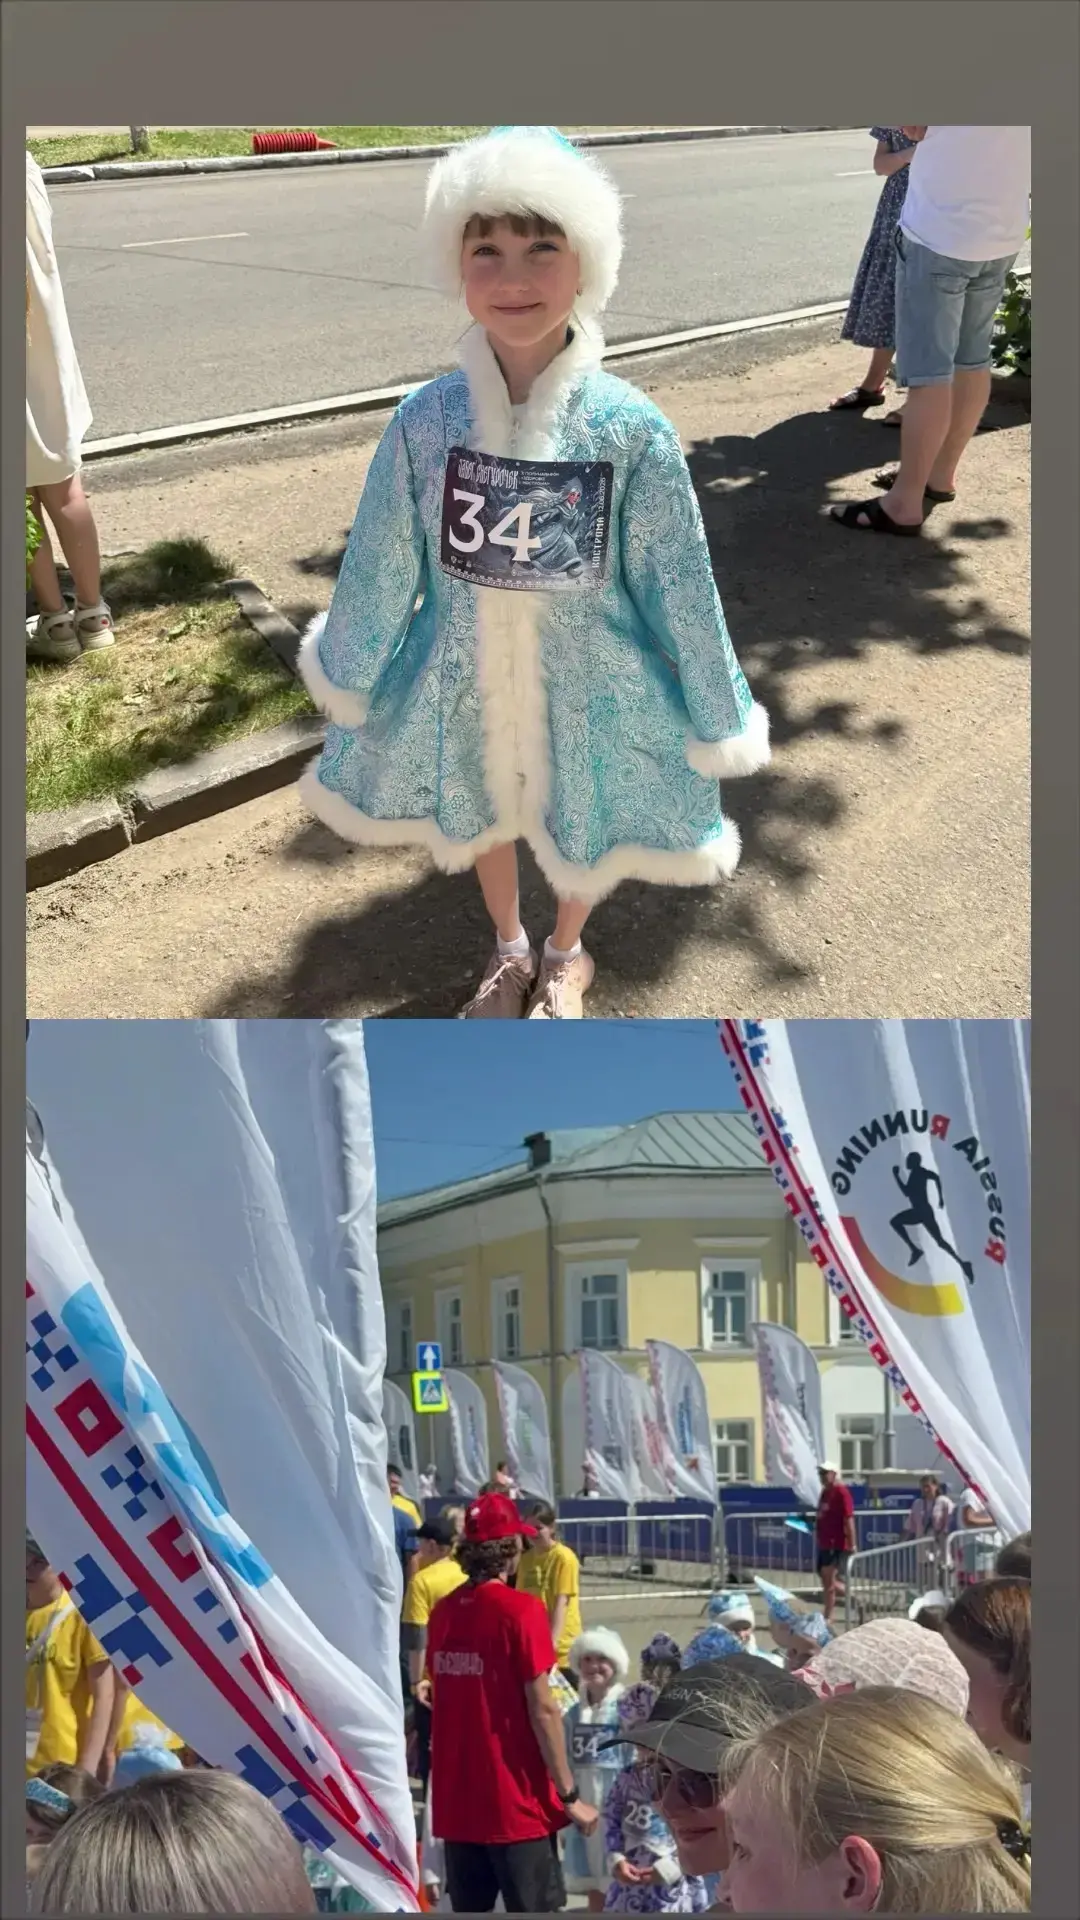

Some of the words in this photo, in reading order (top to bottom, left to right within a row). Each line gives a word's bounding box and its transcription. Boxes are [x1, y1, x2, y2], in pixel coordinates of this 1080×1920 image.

[449, 488, 542, 562] 34
[592, 517, 605, 568] КОСТРОМА
[573, 1736, 598, 1758] 34
[625, 1800, 651, 1829] 28
